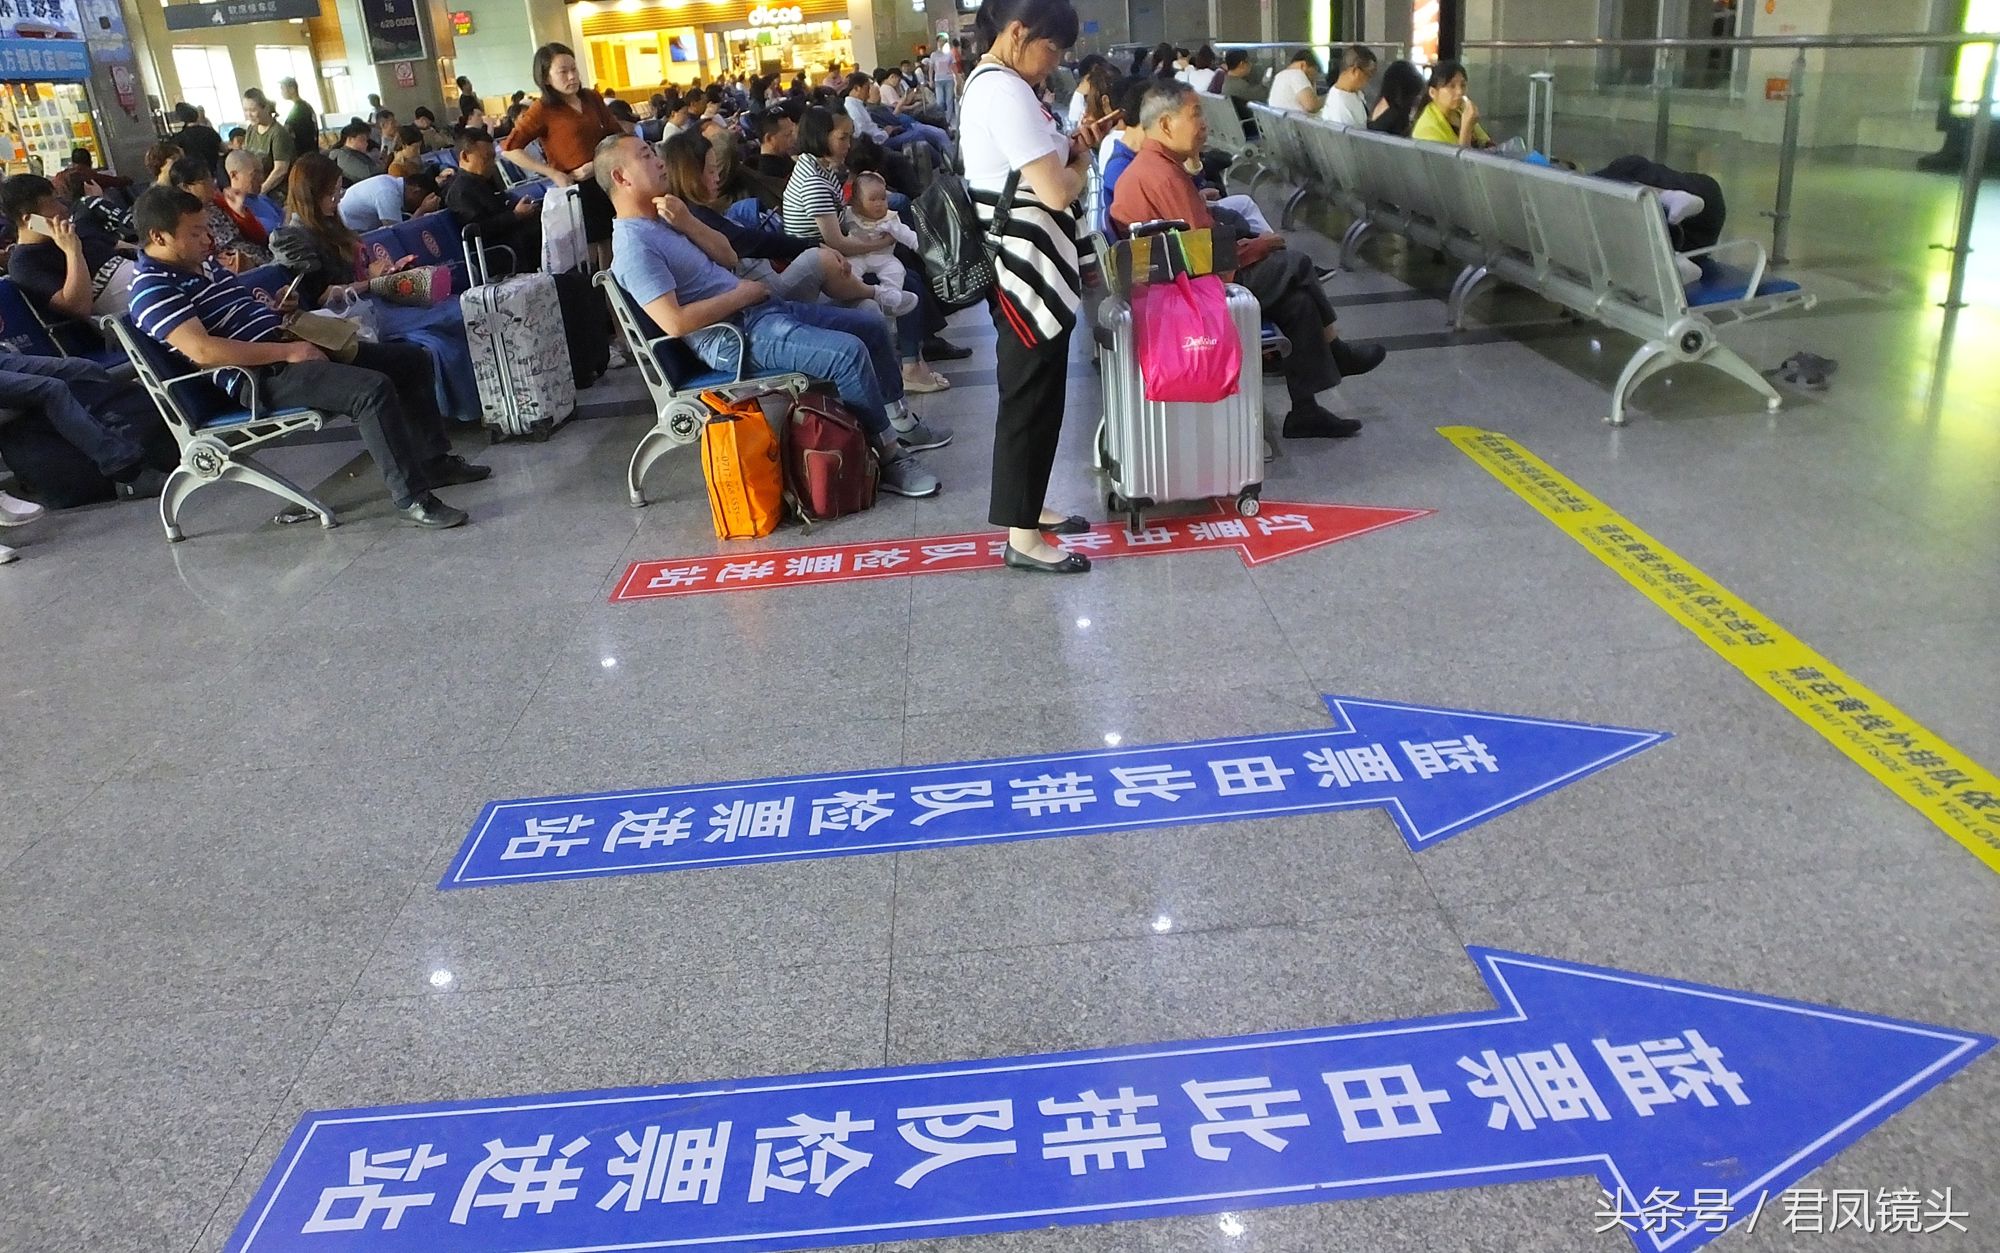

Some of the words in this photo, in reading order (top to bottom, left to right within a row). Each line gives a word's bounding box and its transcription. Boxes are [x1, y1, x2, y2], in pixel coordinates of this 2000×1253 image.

[748, 4, 803, 26] dicos
[648, 514, 1315, 589] 红票由此队检票进站
[499, 732, 1500, 862] 蓝票由此排队检票进站
[1768, 670, 1813, 701] PLEASE
[1808, 703, 1848, 728] WAIT
[1842, 729, 1908, 774] OUTSIDE
[1904, 776, 1940, 797] THE
[1786, 666, 2000, 824] 请在黄线外排队依
[302, 1028, 1751, 1235] 蓝票由此排队检票进站
